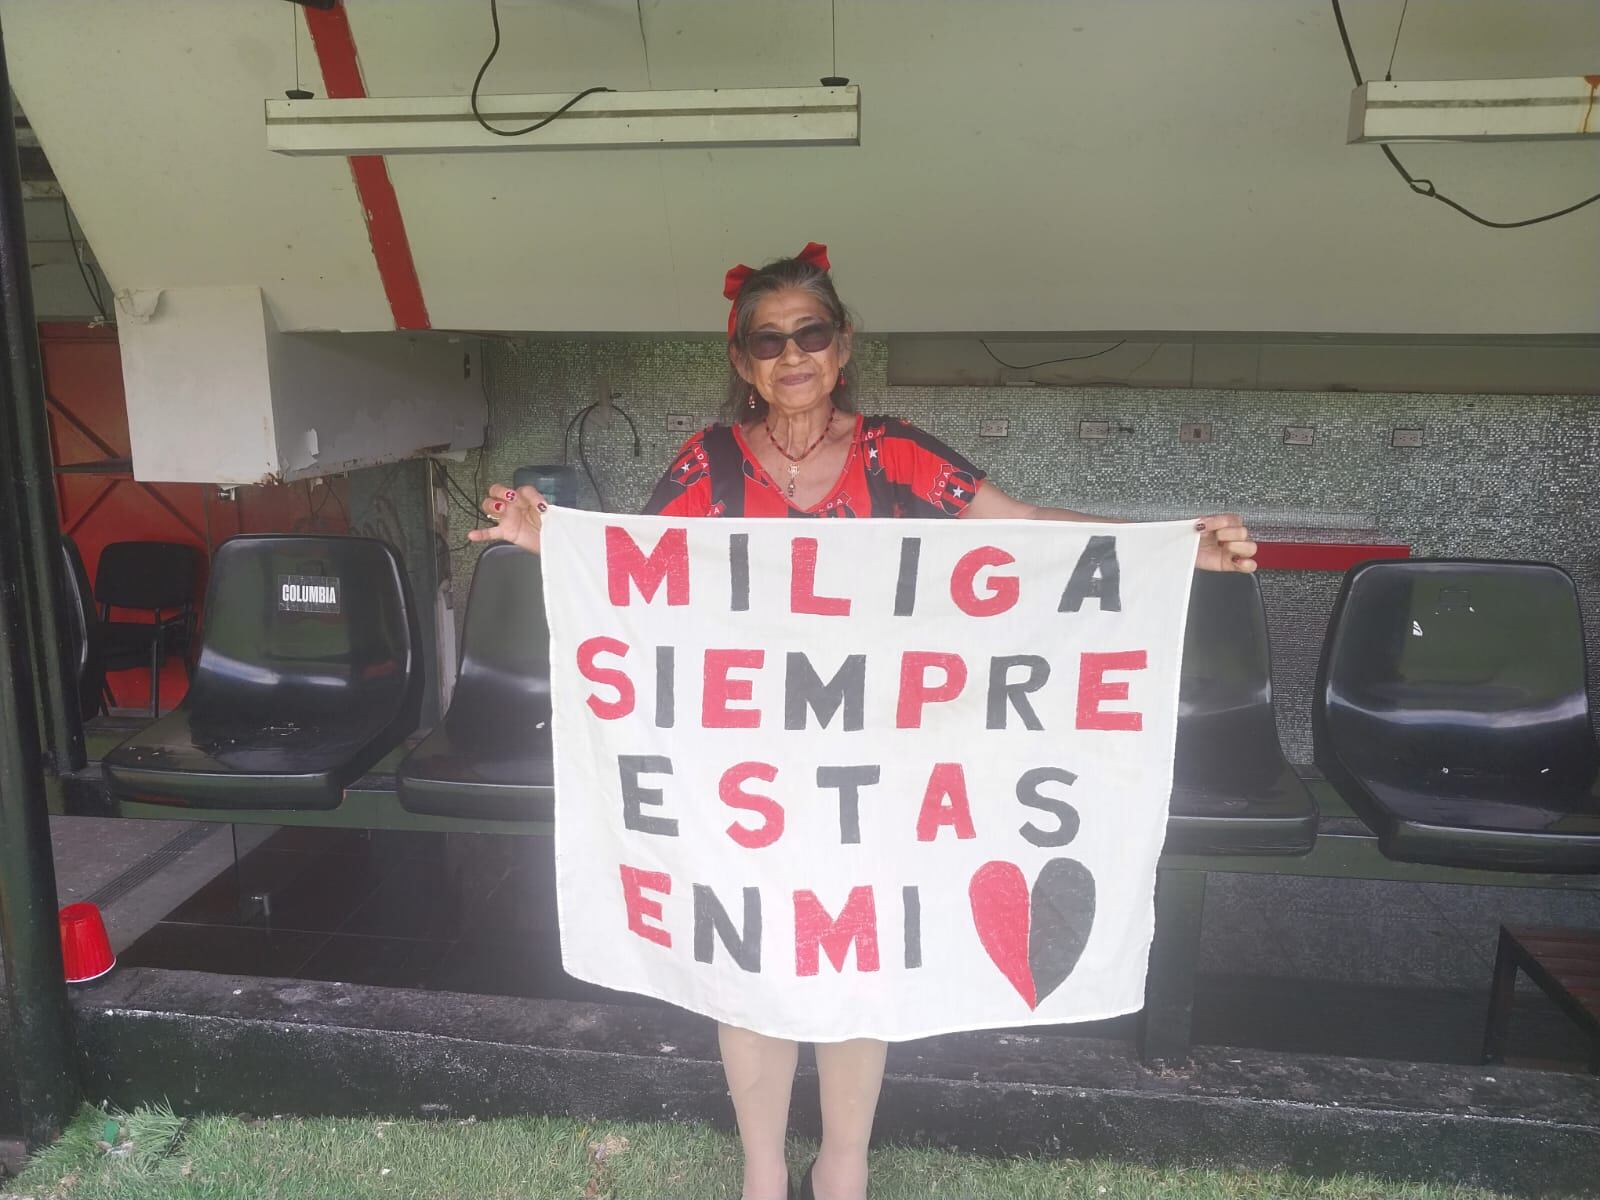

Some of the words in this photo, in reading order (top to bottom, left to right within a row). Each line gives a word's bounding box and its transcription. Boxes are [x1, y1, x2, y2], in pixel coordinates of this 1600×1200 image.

[934, 472, 951, 497] LDA
[282, 584, 337, 604] COLUMBIA
[576, 636, 1148, 732] SIEMPRE
[618, 754, 1081, 849] ESTAS
